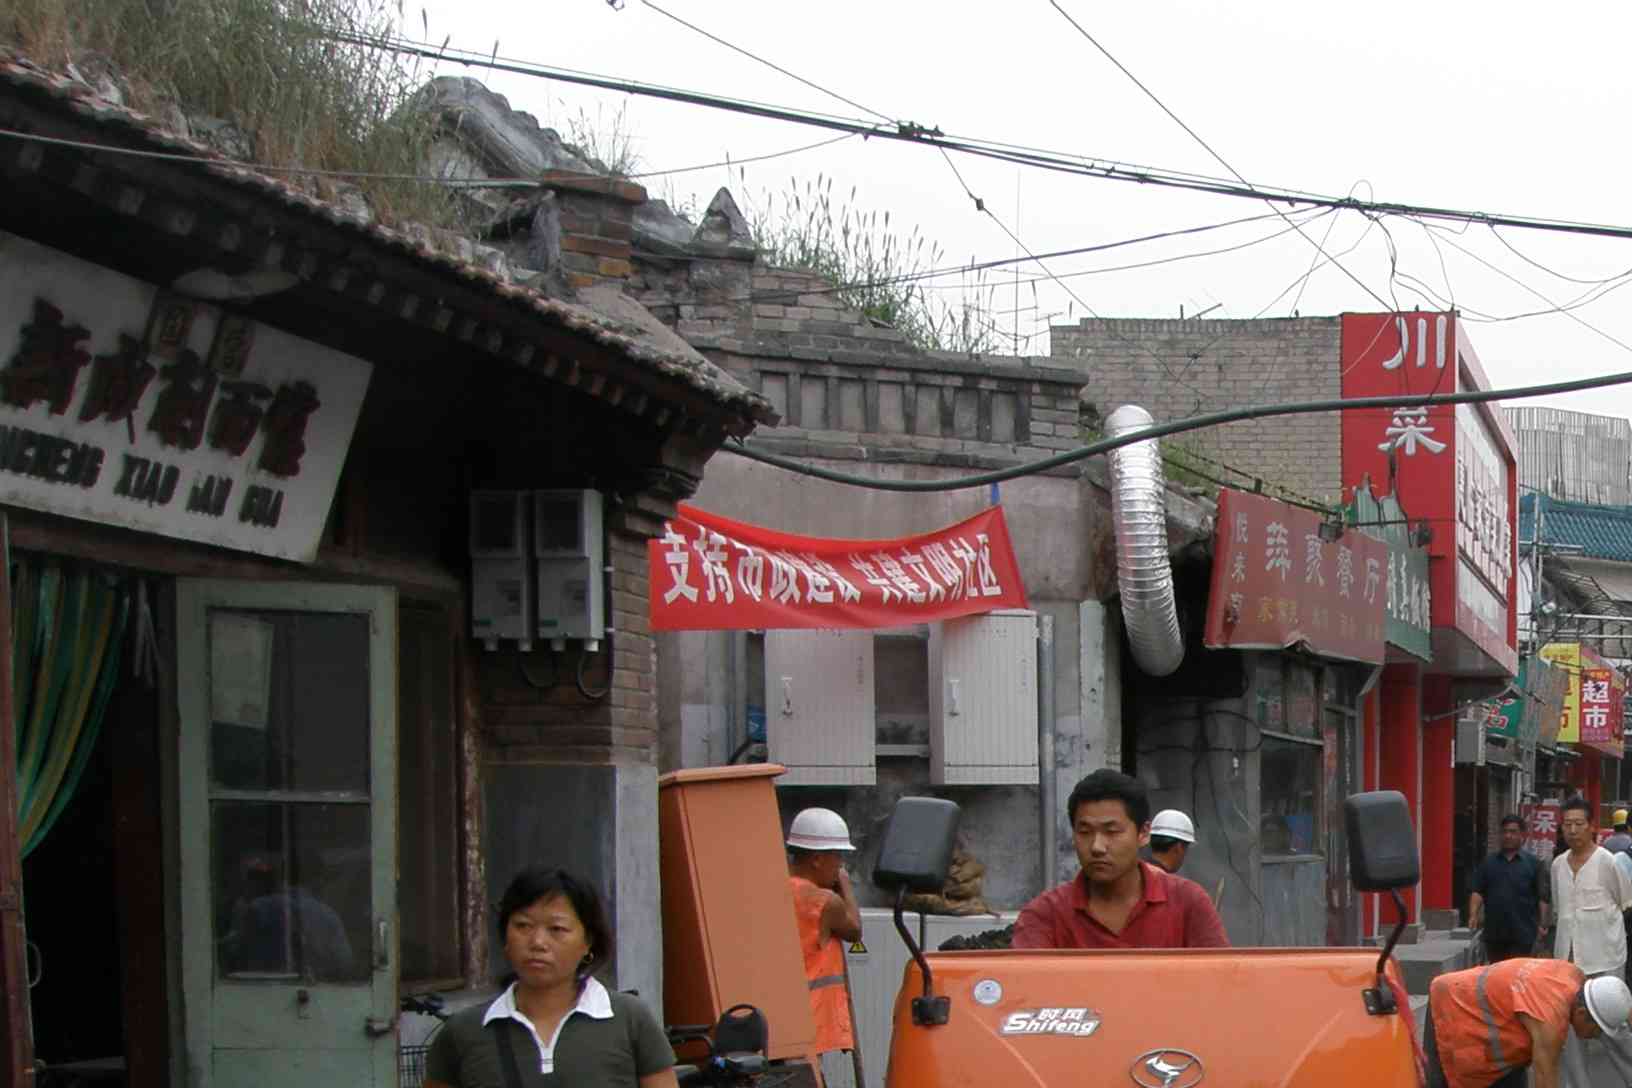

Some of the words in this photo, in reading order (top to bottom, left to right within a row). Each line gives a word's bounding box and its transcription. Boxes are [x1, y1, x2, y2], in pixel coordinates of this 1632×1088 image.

[1378, 315, 1447, 455] 川菜
[1582, 680, 1609, 728] 超市
[1003, 1013, 1099, 1035] Shifeng
[1038, 1008, 1087, 1020] 时风
